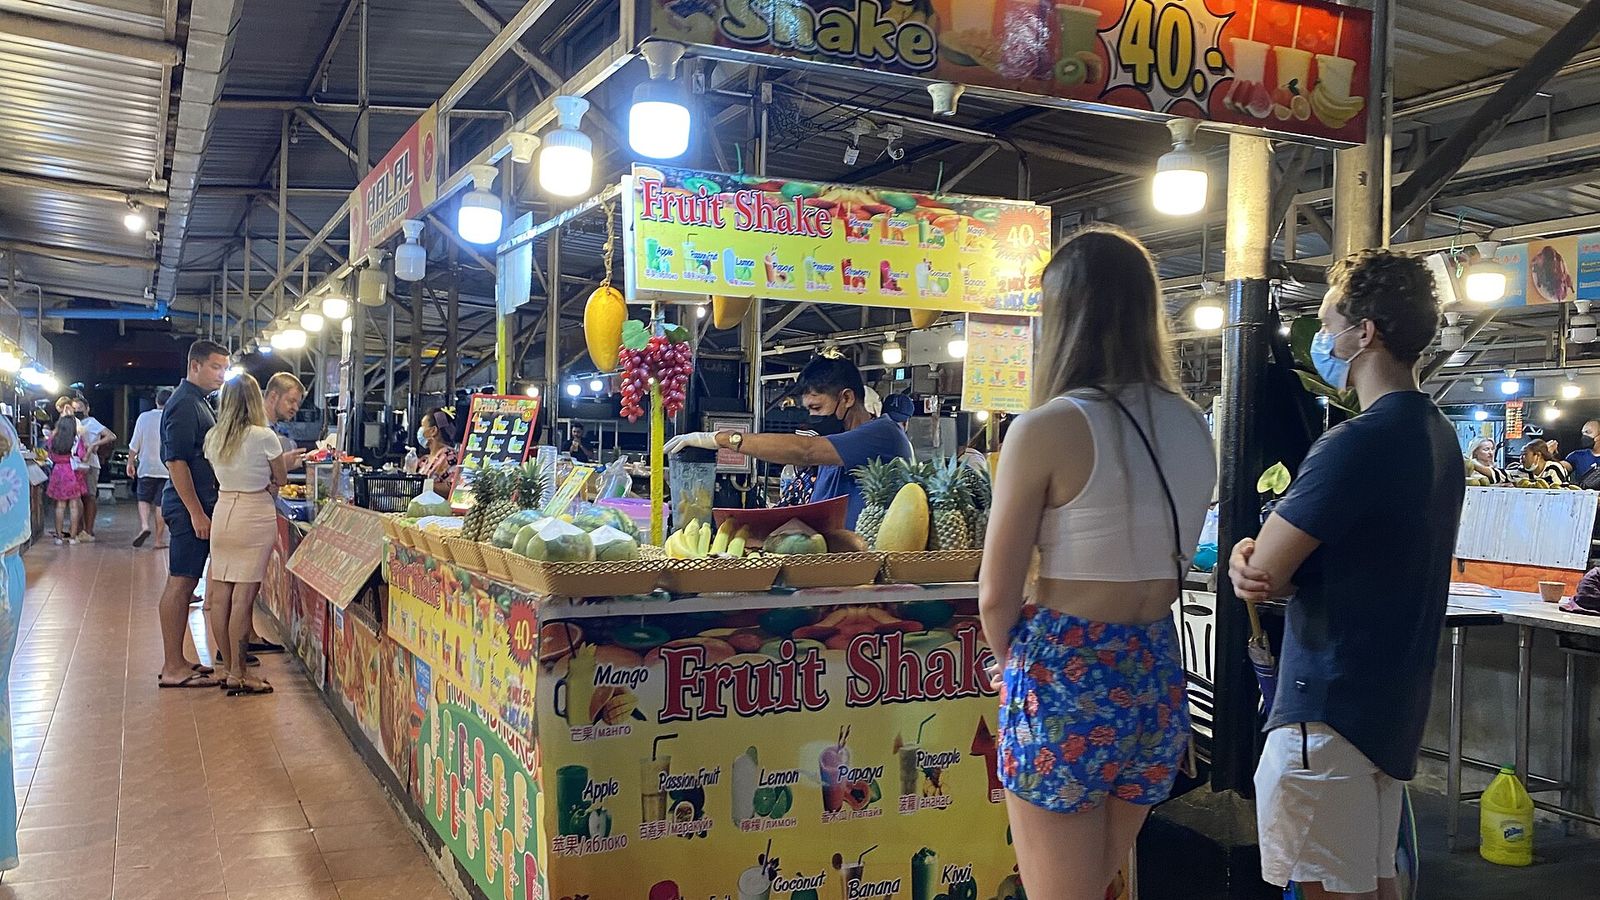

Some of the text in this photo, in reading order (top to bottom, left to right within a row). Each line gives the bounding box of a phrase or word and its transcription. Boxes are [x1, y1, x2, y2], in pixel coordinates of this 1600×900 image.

[720, 0, 938, 69] Shake
[366, 148, 414, 223] HALAL
[387, 191, 410, 221] FOOD
[640, 178, 834, 239] Fruit Shake
[593, 664, 649, 690] Mango
[657, 626, 1000, 724] Fruit Shak
[916, 748, 961, 769] Pineapple
[658, 766, 721, 791] Passion Fruit
[758, 768, 800, 787] Lemon
[838, 765, 884, 784] Papaya
[582, 777, 620, 803] Apple
[773, 870, 827, 892] Coconut
[942, 863, 973, 884] Kiwi
[848, 878, 901, 899] Banana
